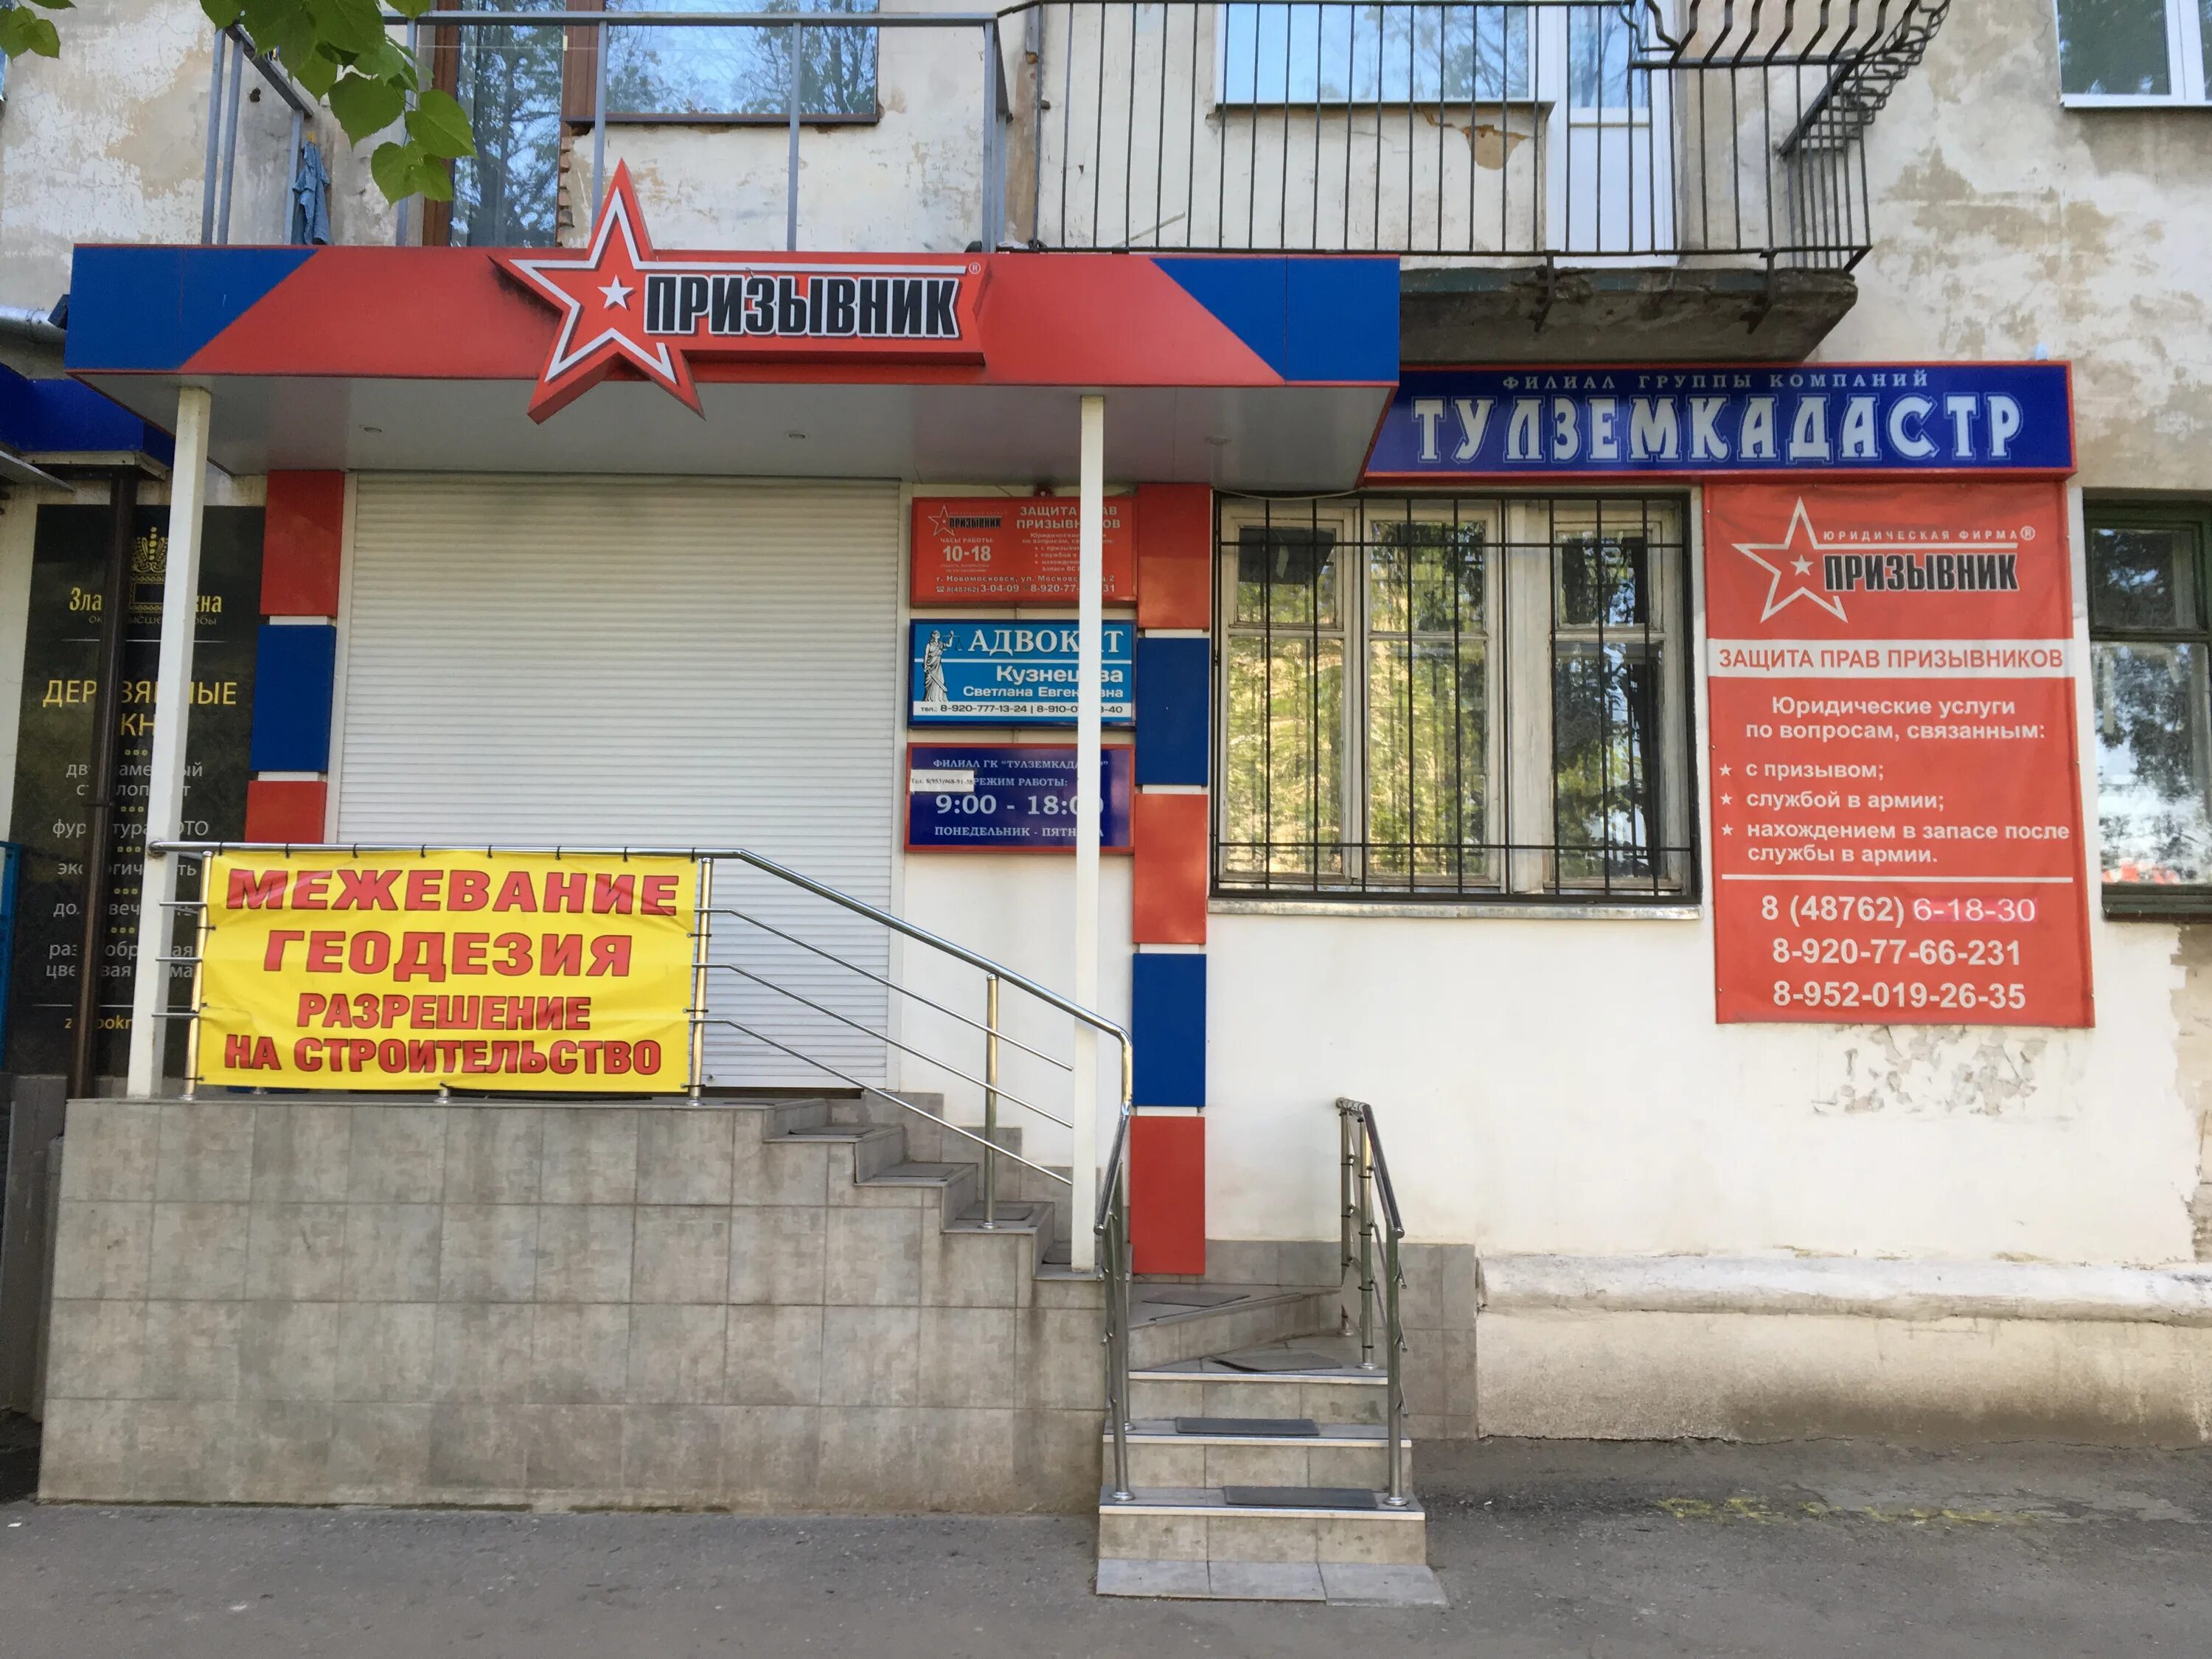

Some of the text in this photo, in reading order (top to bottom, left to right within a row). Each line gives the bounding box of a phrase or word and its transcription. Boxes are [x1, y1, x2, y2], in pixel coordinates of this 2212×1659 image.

[644, 273, 959, 338] ПРИЗЫВНИК
[1503, 369, 1928, 390] ФИЛИАЛ ГРУППЫ КОМПАНИЙ
[1412, 394, 2023, 465] ТУЛЗЕМКАДАСТР
[1020, 507, 1077, 517] ЗАЩИТА
[1016, 519, 1121, 529] ПРИЗЫВНОВ
[1823, 529, 1950, 542] ЮРИДИЧЕСКАЯ
[1959, 529, 2018, 540] ФИРМА
[943, 546, 991, 562] 10-18
[947, 575, 1018, 583] Новомосковск,
[1824, 554, 2020, 592] ПРИЗЫВНИК
[981, 584, 1019, 592] 3-04-09
[1031, 584, 1115, 593] 8-920-77-31
[968, 629, 1124, 656] АДВОКТ
[1719, 648, 2063, 671] ЗАЩИТА ПРАВ ПРИЗЫВНИКОВ
[997, 665, 1124, 686] Кузнецва
[963, 685, 1124, 698] Светлана Евгенвна
[940, 704, 1028, 713] 8-920-777-13-24
[1772, 696, 2015, 718] Юридические услуги
[1746, 723, 2046, 742] по вопросам, связанным:
[933, 759, 981, 768] ФИЛИАЛ
[983, 760, 998, 768] ГК
[1746, 762, 1885, 780] с призывом;
[974, 777, 1068, 787] РЕЖИМ РАБОТЫ:
[936, 794, 997, 815] 9:00
[1746, 790, 1945, 813] службой в армии;
[934, 826, 1030, 838] ПОНЕДЕЛЬНИК
[1747, 824, 2070, 841] нахождением в запасе после
[1747, 845, 1938, 866] службы в армии.
[226, 868, 679, 917] МЕЖЕВАНИЕ
[1761, 894, 2037, 928] 8 (48762) 6-18-30
[263, 931, 633, 982] ГЕОДЕЗИЯ
[1773, 937, 2021, 966] 8-920-77-66-231
[1773, 980, 2027, 1009] 8-952-019-26-35
[296, 992, 592, 1032] РАЗРЕШЕНИЕ
[224, 1034, 662, 1076] НА СТРОИТЕЛЬСТВО
